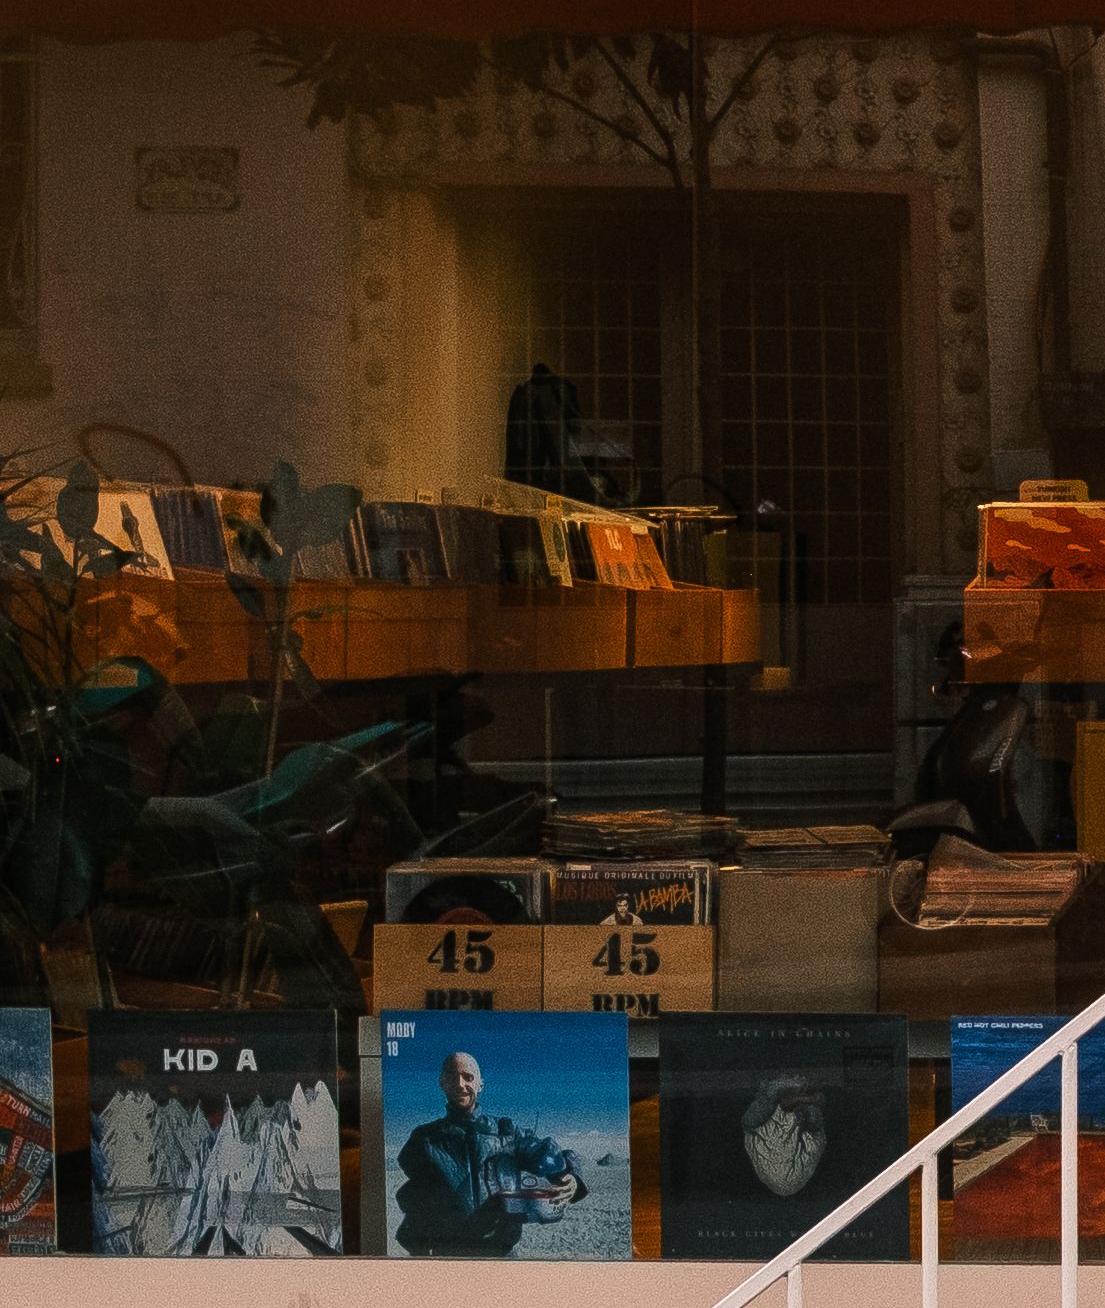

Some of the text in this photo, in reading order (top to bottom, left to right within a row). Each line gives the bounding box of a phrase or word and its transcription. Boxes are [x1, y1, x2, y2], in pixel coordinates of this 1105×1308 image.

[648, 881, 695, 914] BAMBA
[427, 930, 496, 974] 45
[591, 932, 662, 976] 45
[425, 989, 493, 1011] RPM
[592, 993, 660, 1020] RPM
[386, 1021, 416, 1038] MOBY
[162, 1048, 258, 1072] KID A
[386, 1041, 399, 1057] 18
